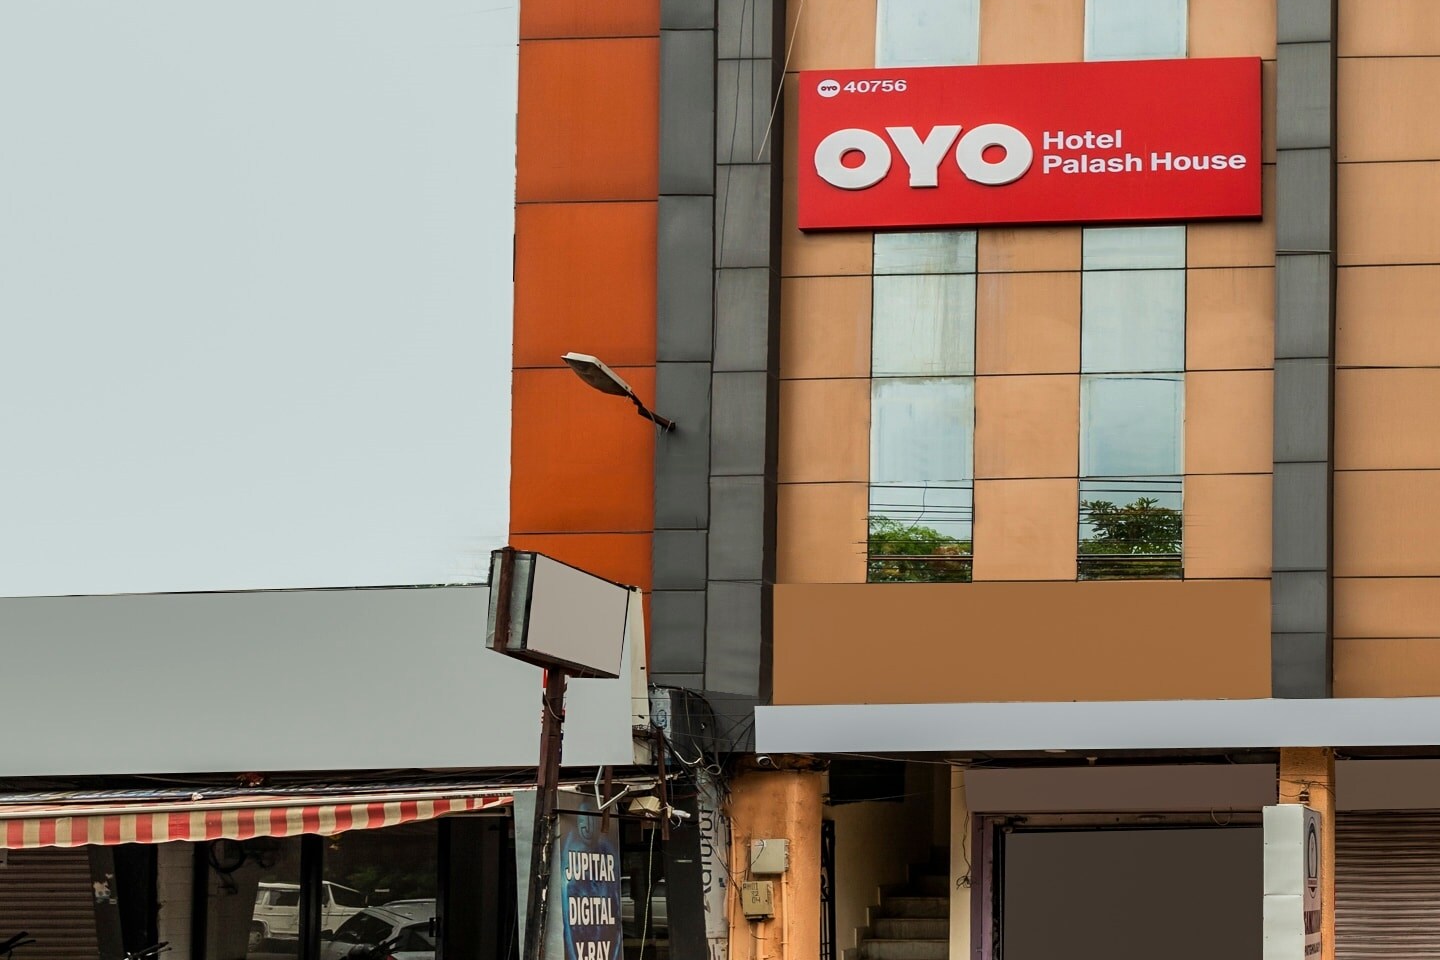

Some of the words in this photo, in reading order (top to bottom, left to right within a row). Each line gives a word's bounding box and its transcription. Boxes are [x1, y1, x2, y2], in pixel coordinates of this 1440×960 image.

[843, 80, 907, 93] 40756
[1043, 129, 1122, 150] Hotel
[814, 123, 1033, 190] OYO
[1043, 153, 1143, 174] Palash
[1151, 152, 1247, 171] House
[566, 851, 615, 881] JUPITAR
[569, 896, 616, 925] DIGITAL
